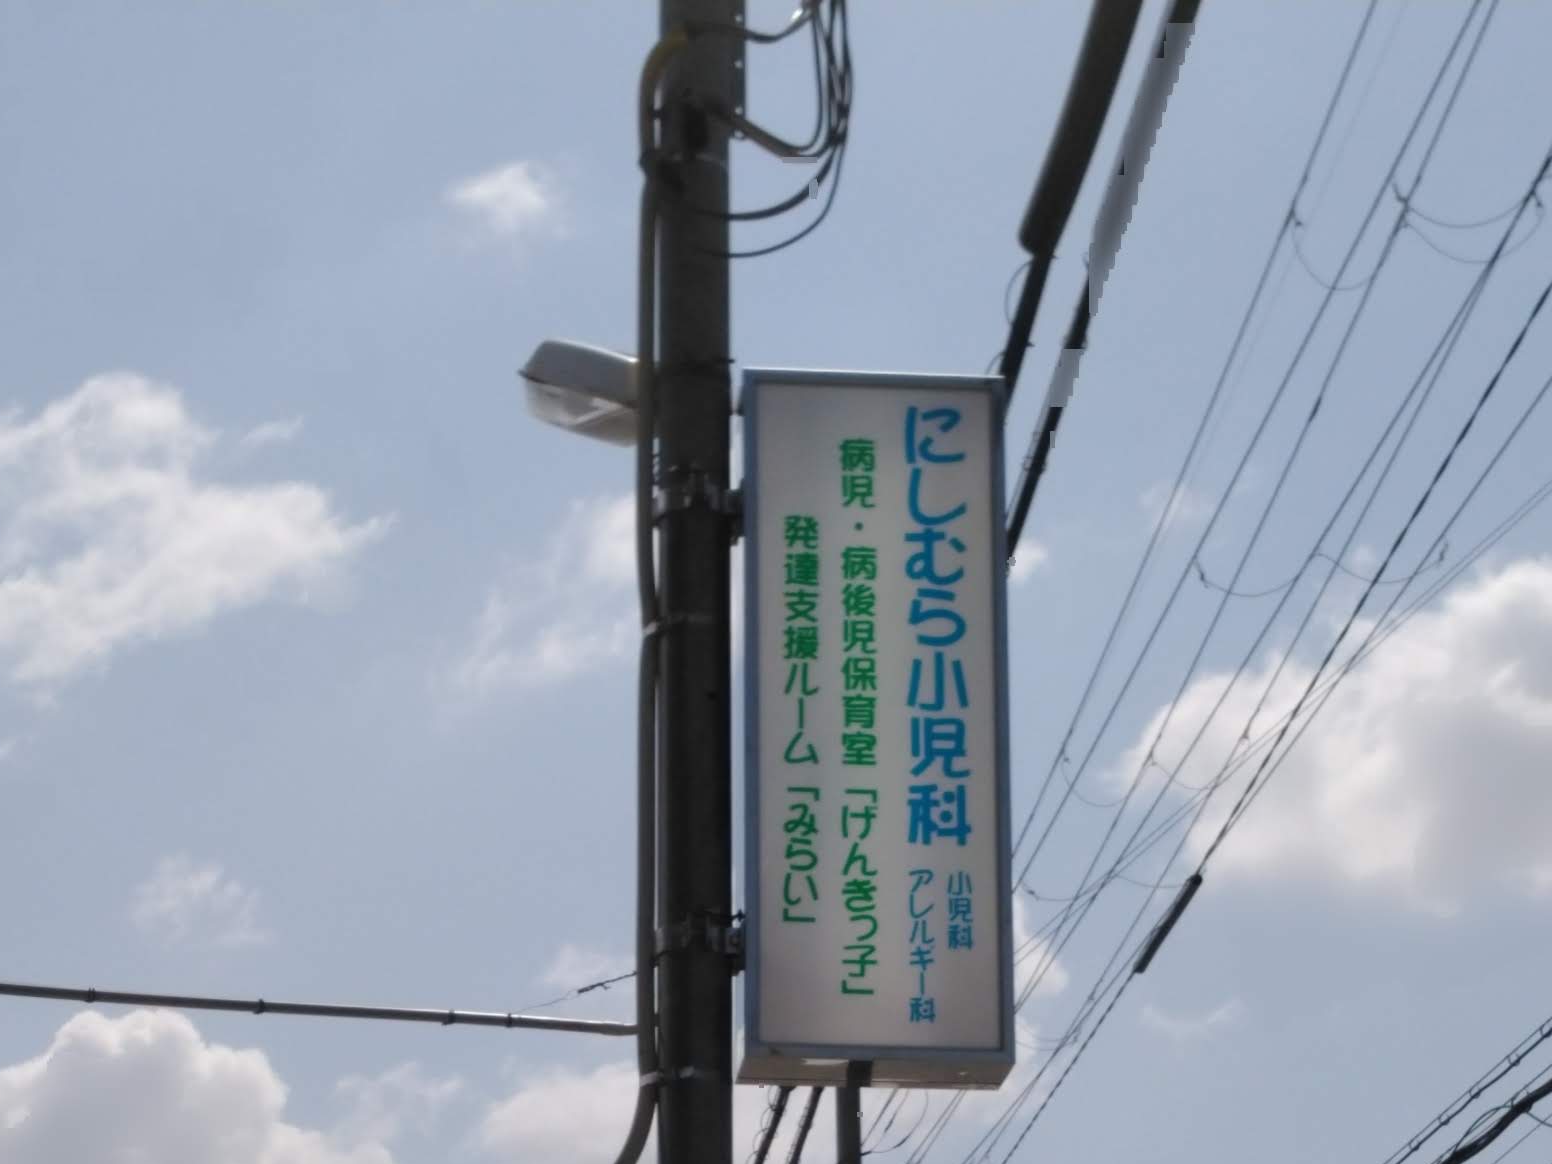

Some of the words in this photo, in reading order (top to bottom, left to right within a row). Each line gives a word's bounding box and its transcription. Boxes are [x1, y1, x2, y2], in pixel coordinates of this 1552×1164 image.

[782, 514, 820, 924] 発達支援ルーム「みらい」
[838, 437, 879, 995] 病児・病後児保育室「げんきっ子」
[904, 405, 972, 847] にしむら小児科
[909, 868, 937, 1023] アレルギー科
[947, 870, 974, 950] 小児科
